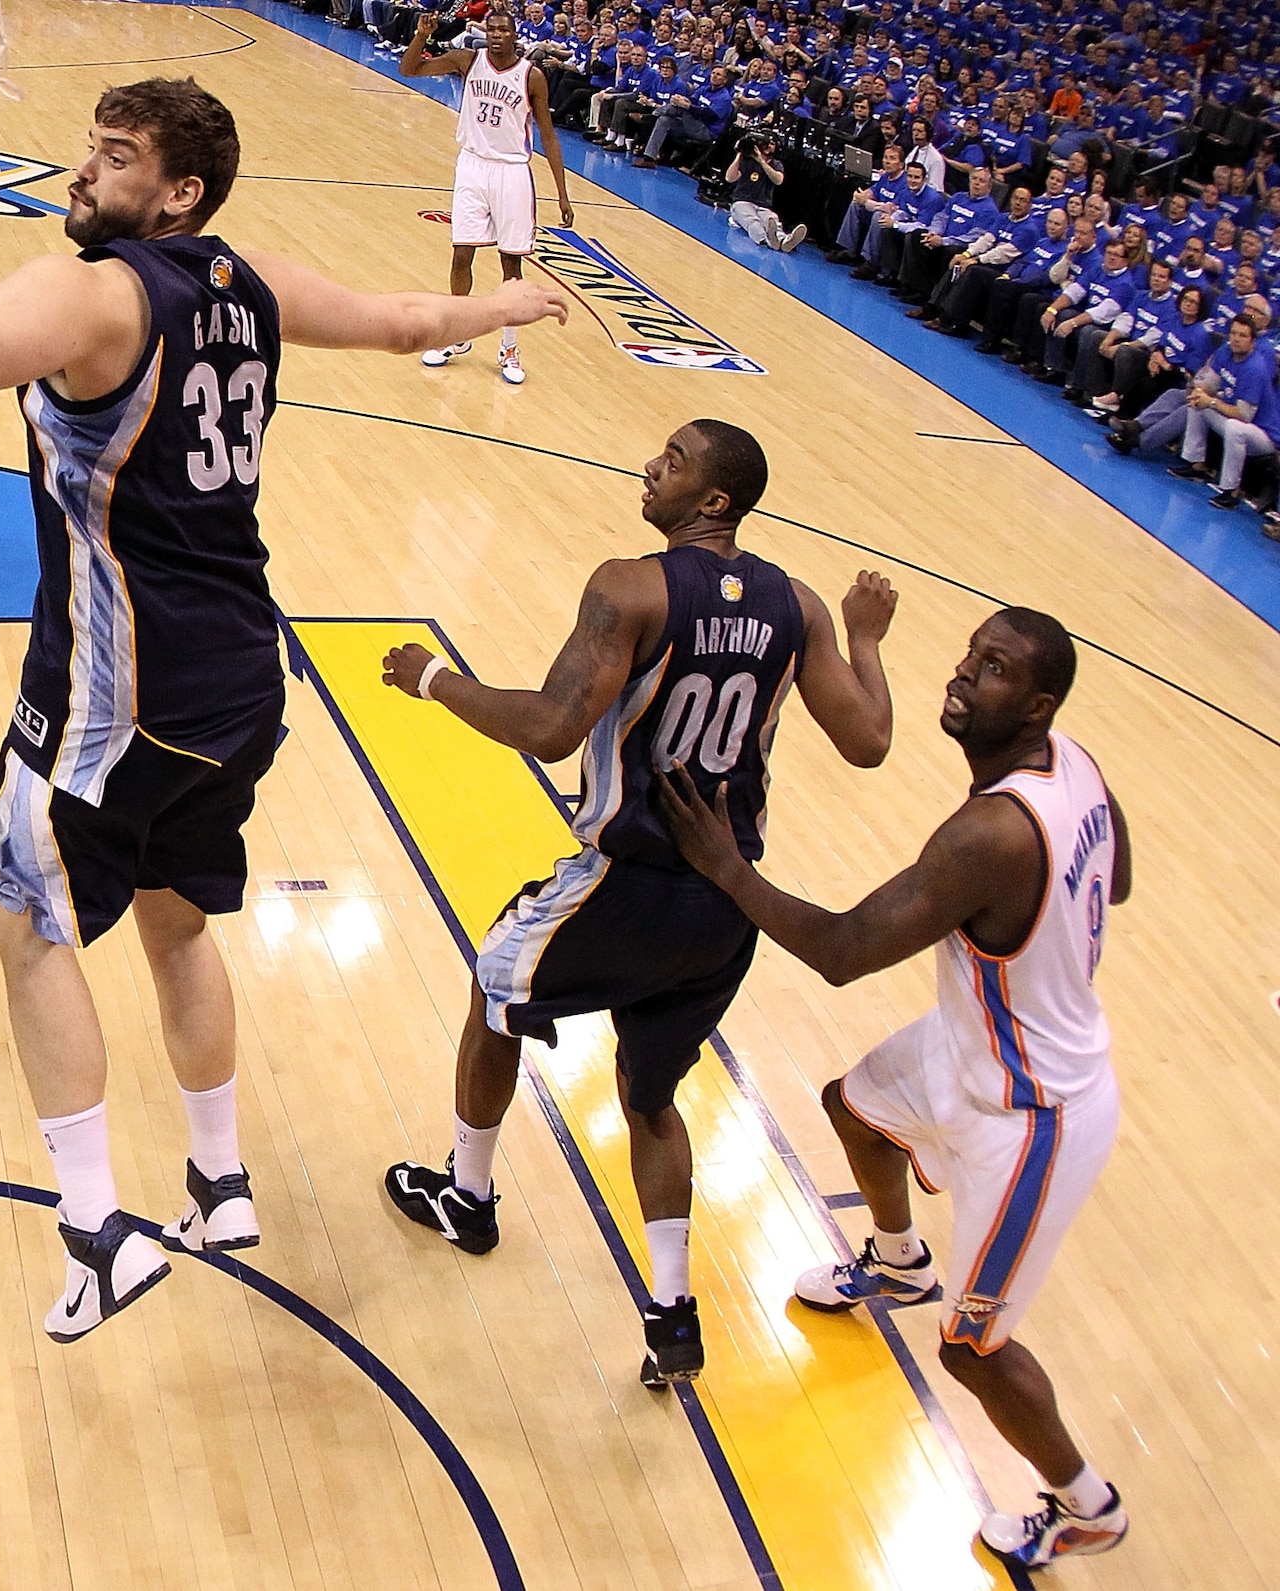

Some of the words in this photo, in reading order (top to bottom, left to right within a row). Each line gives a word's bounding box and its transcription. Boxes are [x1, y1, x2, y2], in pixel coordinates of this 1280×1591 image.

[470, 79, 522, 110] THUNDER
[477, 102, 503, 127] 35
[193, 302, 258, 352] GASOL
[183, 361, 268, 492] 33
[693, 616, 774, 661] ARTHUR
[650, 672, 757, 773] 00
